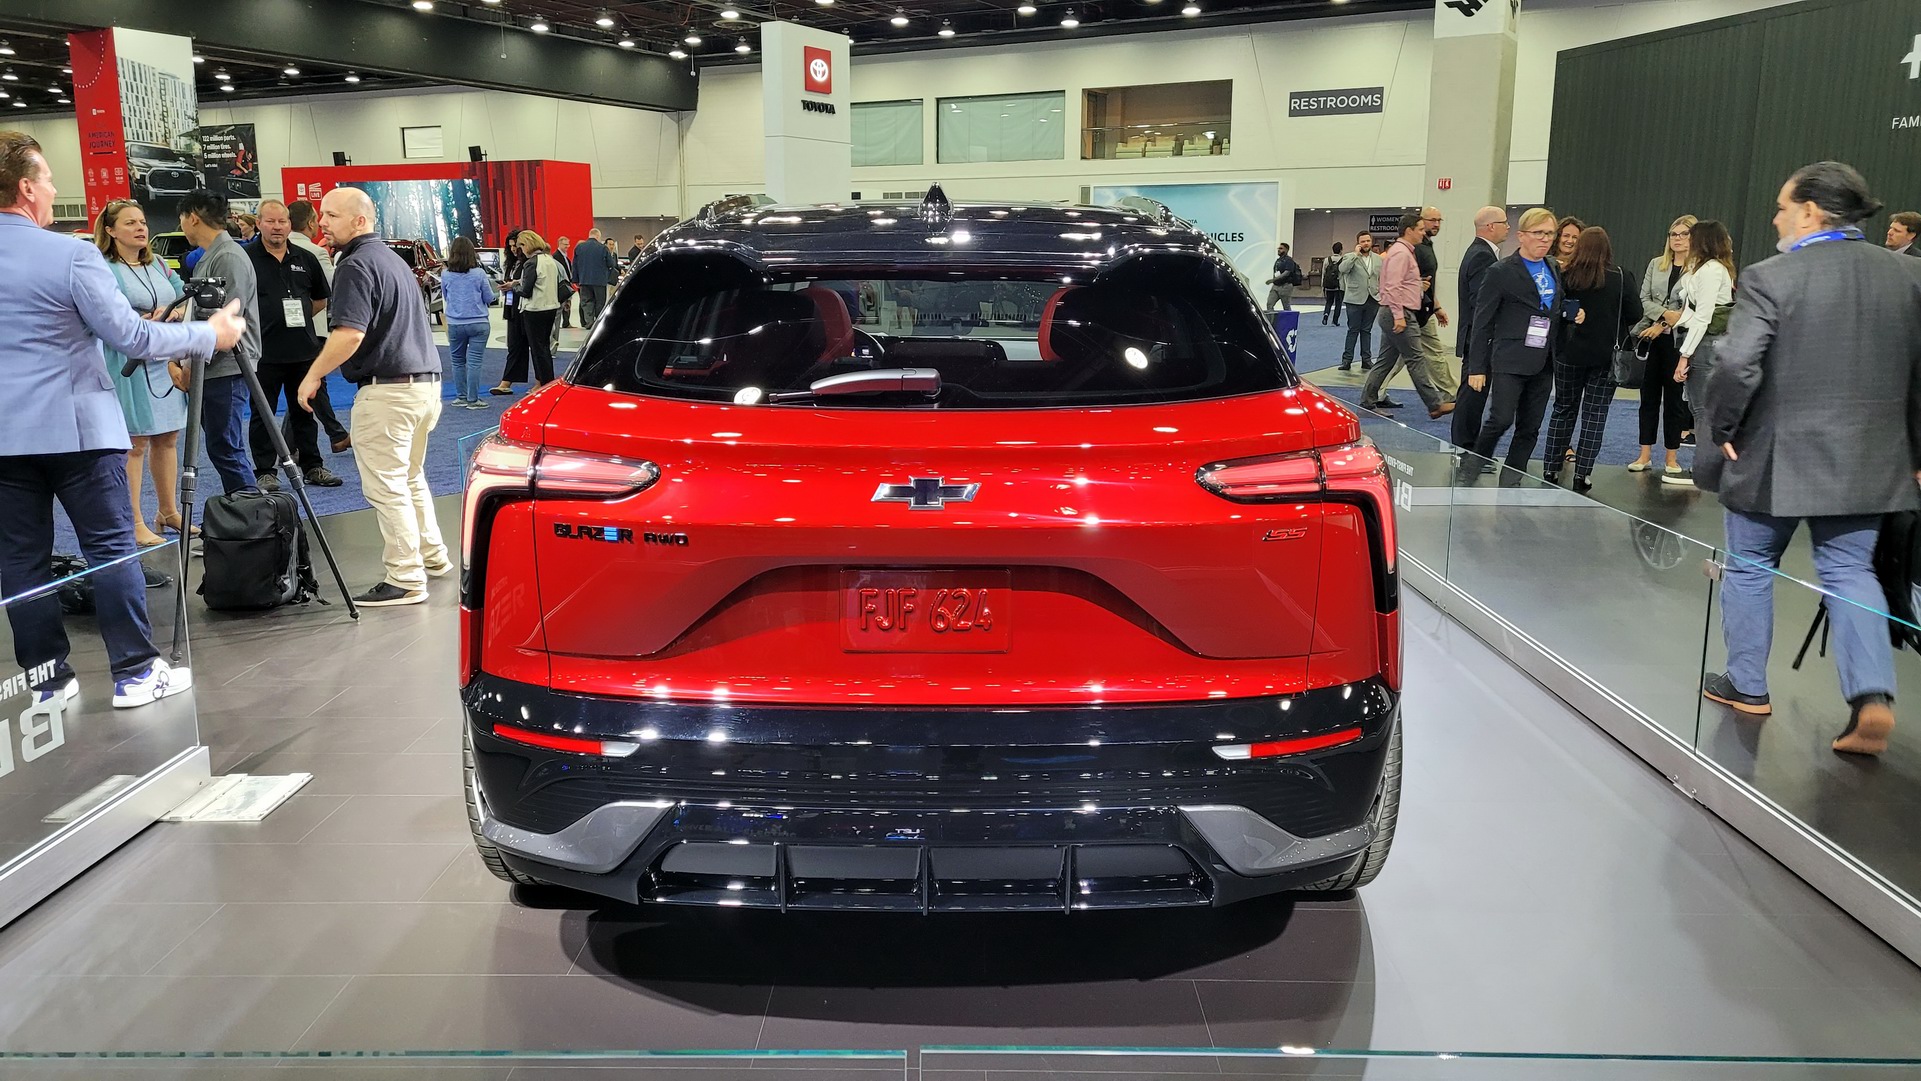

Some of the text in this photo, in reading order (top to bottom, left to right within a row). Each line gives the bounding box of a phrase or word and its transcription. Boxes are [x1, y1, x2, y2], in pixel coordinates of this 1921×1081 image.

[801, 99, 836, 115] TOYOTA
[1290, 94, 1382, 110] RESTROOMS
[1891, 115, 1921, 130] FAM
[210, 134, 224, 142] million
[554, 522, 690, 547] BLAZER AWD
[859, 588, 993, 632] FJF 624
